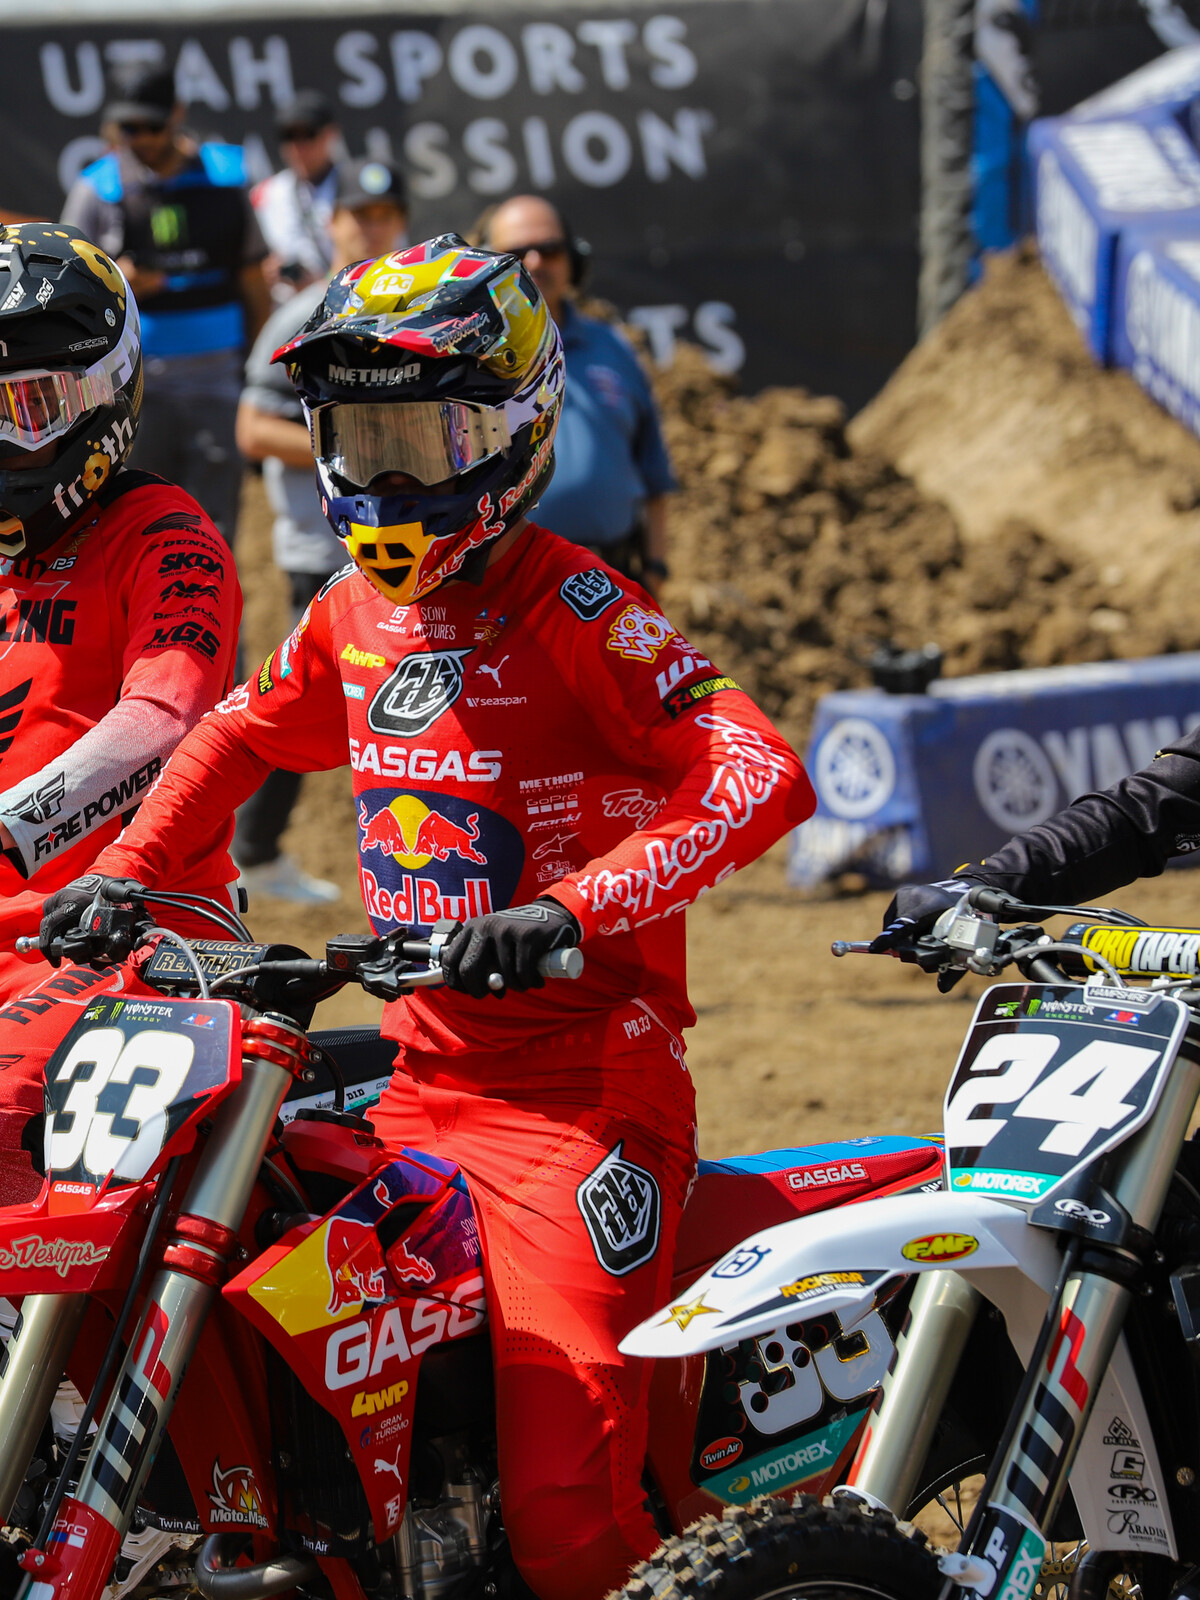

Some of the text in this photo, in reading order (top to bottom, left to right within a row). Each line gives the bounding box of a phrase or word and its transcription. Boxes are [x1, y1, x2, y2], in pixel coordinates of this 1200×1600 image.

[332, 15, 699, 108] SPORTS
[329, 363, 421, 382] METHOD
[52, 417, 134, 520] froth
[421, 607, 446, 621] SONY
[376, 622, 407, 634] GASGAS
[413, 623, 456, 640] PICTURES
[480, 696, 527, 708] seaspan
[350, 738, 503, 783] GASGAS
[84, 755, 162, 829] POWER
[519, 771, 584, 790] METHOD
[526, 793, 578, 806] GoPro
[362, 867, 493, 926] Red Bull
[1088, 986, 1148, 1004] HAMPSHIRE
[123, 1003, 173, 1018] MONSTER
[126, 1015, 161, 1024] ENERGY
[1040, 1000, 1095, 1016] MONSTER
[623, 1014, 651, 1039] PB33
[44, 1027, 195, 1182] 33
[947, 1033, 1162, 1157] 24
[787, 1163, 867, 1190] GASGAS
[970, 1171, 1047, 1195] MOTOREX
[53, 1183, 92, 1196] GASGAS
[11, 1235, 110, 1278] Designs
[904, 1235, 977, 1261] FMF
[779, 1272, 866, 1299] ROCKSTAR
[374, 1418, 410, 1441] TURISMO
[379, 1412, 402, 1430] GRAN
[702, 1441, 741, 1467] Twin Air
[750, 1439, 833, 1488] MOTOREX
[158, 1516, 201, 1531] Twin Air
